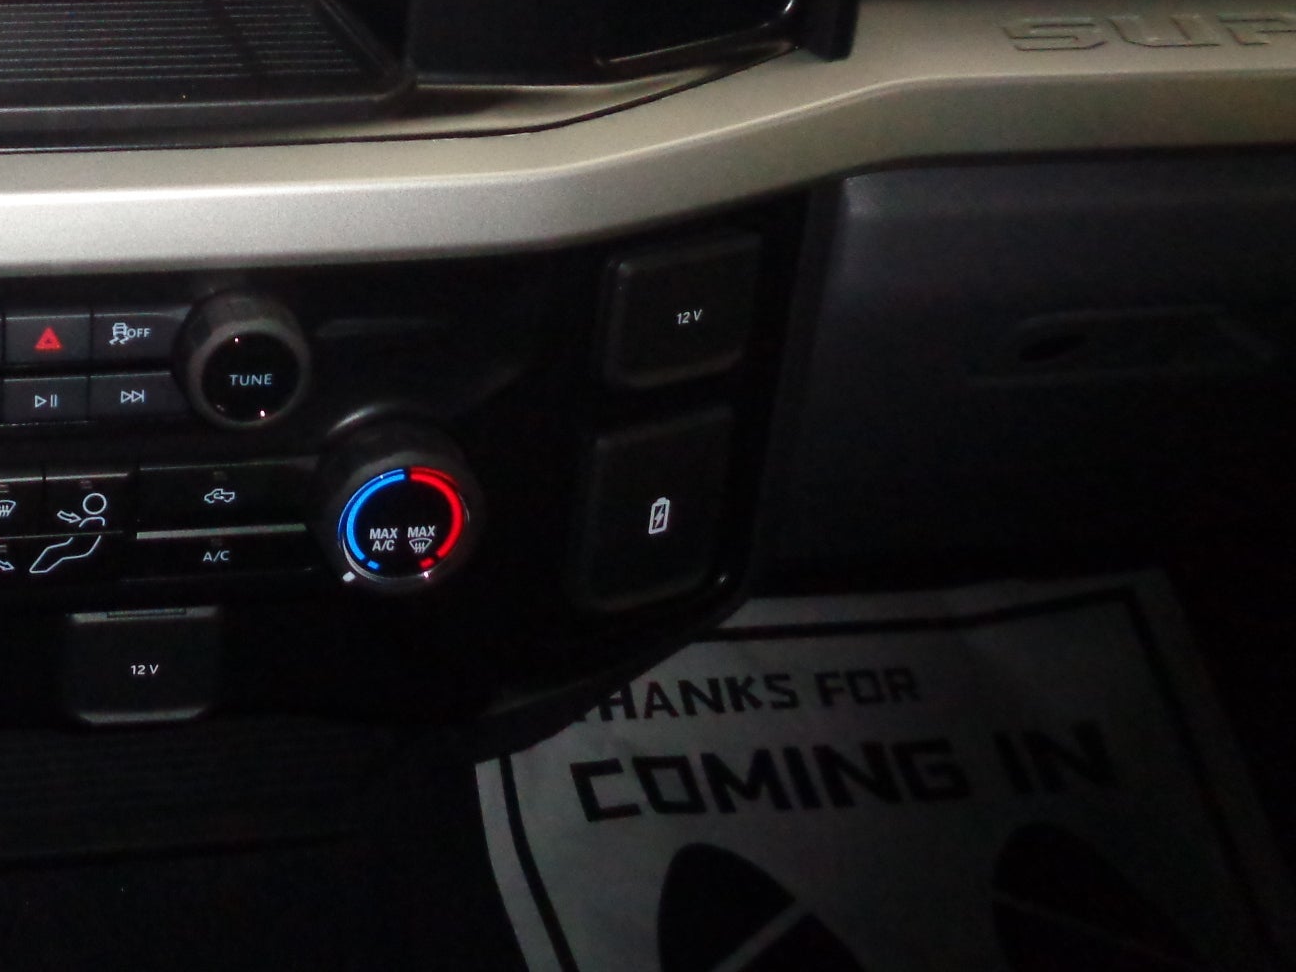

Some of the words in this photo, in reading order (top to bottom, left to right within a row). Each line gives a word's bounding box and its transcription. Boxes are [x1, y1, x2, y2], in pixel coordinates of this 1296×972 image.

[676, 311, 691, 325] 12
[693, 308, 703, 322] V
[127, 328, 151, 338] OFF
[229, 373, 273, 386] TUNE
[369, 528, 398, 540] MAX
[407, 526, 436, 537] MAX
[372, 540, 395, 552] A/C
[202, 550, 230, 563] A/C
[130, 664, 146, 675] 12
[149, 664, 159, 675] V
[580, 673, 800, 724] HANKS
[814, 666, 922, 707] FOR
[570, 737, 971, 823] COMING
[994, 720, 1118, 795] IN
